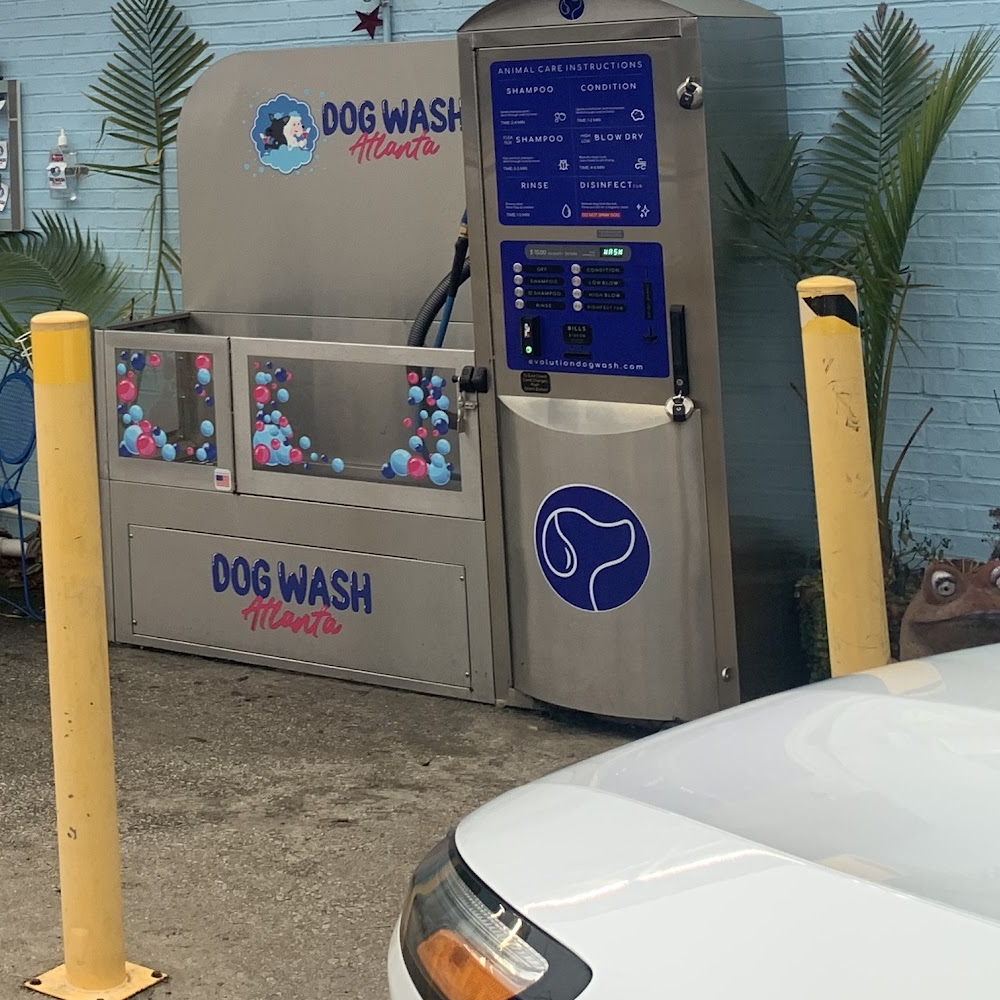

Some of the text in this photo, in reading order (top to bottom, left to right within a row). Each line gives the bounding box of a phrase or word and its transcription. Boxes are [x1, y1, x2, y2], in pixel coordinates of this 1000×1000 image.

[498, 60, 643, 75] ANIMAL CARE INSTRUCTIONS
[506, 85, 554, 95] SHAMPOO
[580, 82, 637, 92] CONDITION
[322, 97, 462, 136] DOG WASH
[515, 135, 564, 144] SHAMPOO
[594, 133, 644, 141] BLOW DRY
[349, 129, 440, 164] Atlanta
[520, 181, 549, 189] RINSE
[580, 181, 633, 189] DISINFECT
[528, 358, 644, 370] evolutiondogwash.com
[212, 552, 372, 614] DOG WASH
[242, 595, 343, 638] Atlanta
